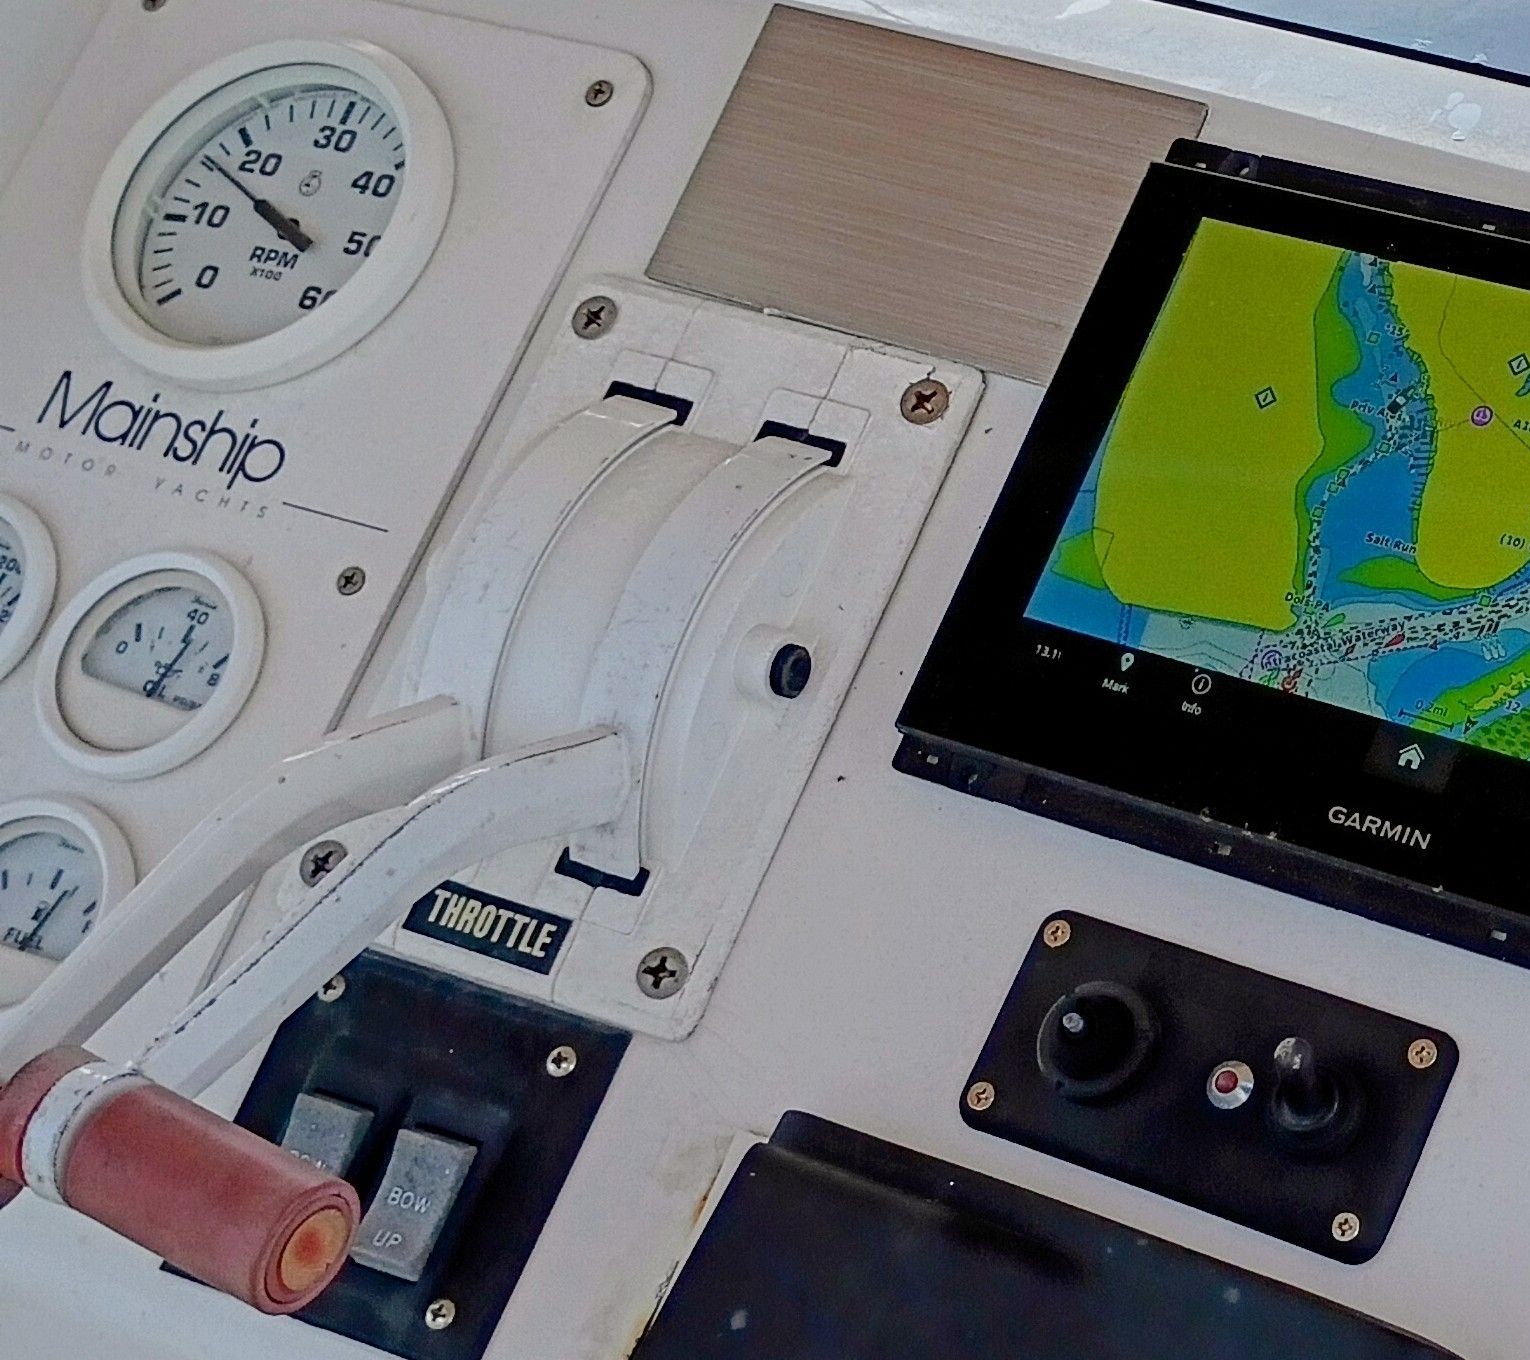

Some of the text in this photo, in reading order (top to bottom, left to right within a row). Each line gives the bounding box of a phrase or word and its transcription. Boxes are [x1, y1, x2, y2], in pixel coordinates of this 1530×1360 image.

[313, 125, 358, 153] 30
[238, 150, 283, 177] 20
[350, 170, 395, 198] 40
[193, 201, 231, 229] 10
[249, 245, 299, 271] RPM
[195, 265, 219, 290] 0
[37, 369, 286, 490] Mainship
[16, 440, 268, 520] MOTOR YACHTS
[1365, 531, 1418, 555] Salt Run
[1499, 533, 1525, 549] (10)
[186, 608, 210, 626] 40
[1101, 677, 1130, 695] Mark
[1180, 700, 1203, 716] Info
[1327, 804, 1433, 851] GARMIN
[427, 888, 558, 958] THROTTLE
[387, 1186, 432, 1214] BOW
[372, 1229, 403, 1248] UP
